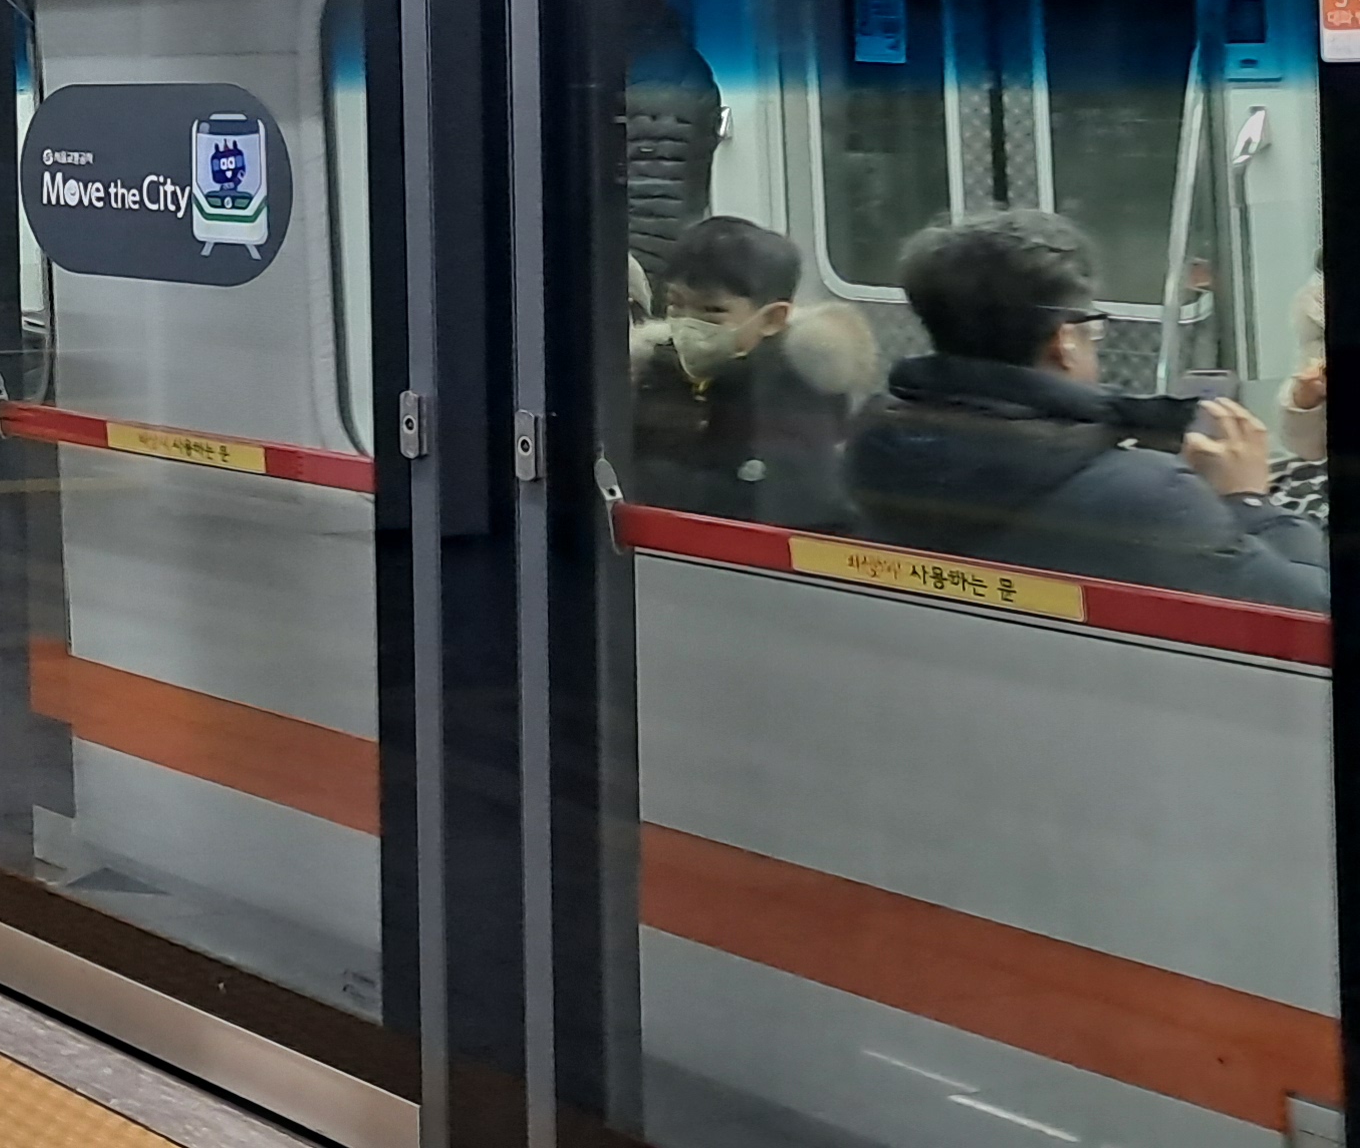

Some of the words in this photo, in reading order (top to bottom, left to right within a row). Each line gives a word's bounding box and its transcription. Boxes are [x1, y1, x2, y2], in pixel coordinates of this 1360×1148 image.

[43, 171, 105, 208] Move
[108, 179, 140, 209] the
[142, 174, 191, 218] City
[909, 565, 988, 597] 사용하는
[997, 578, 1017, 602] 문
